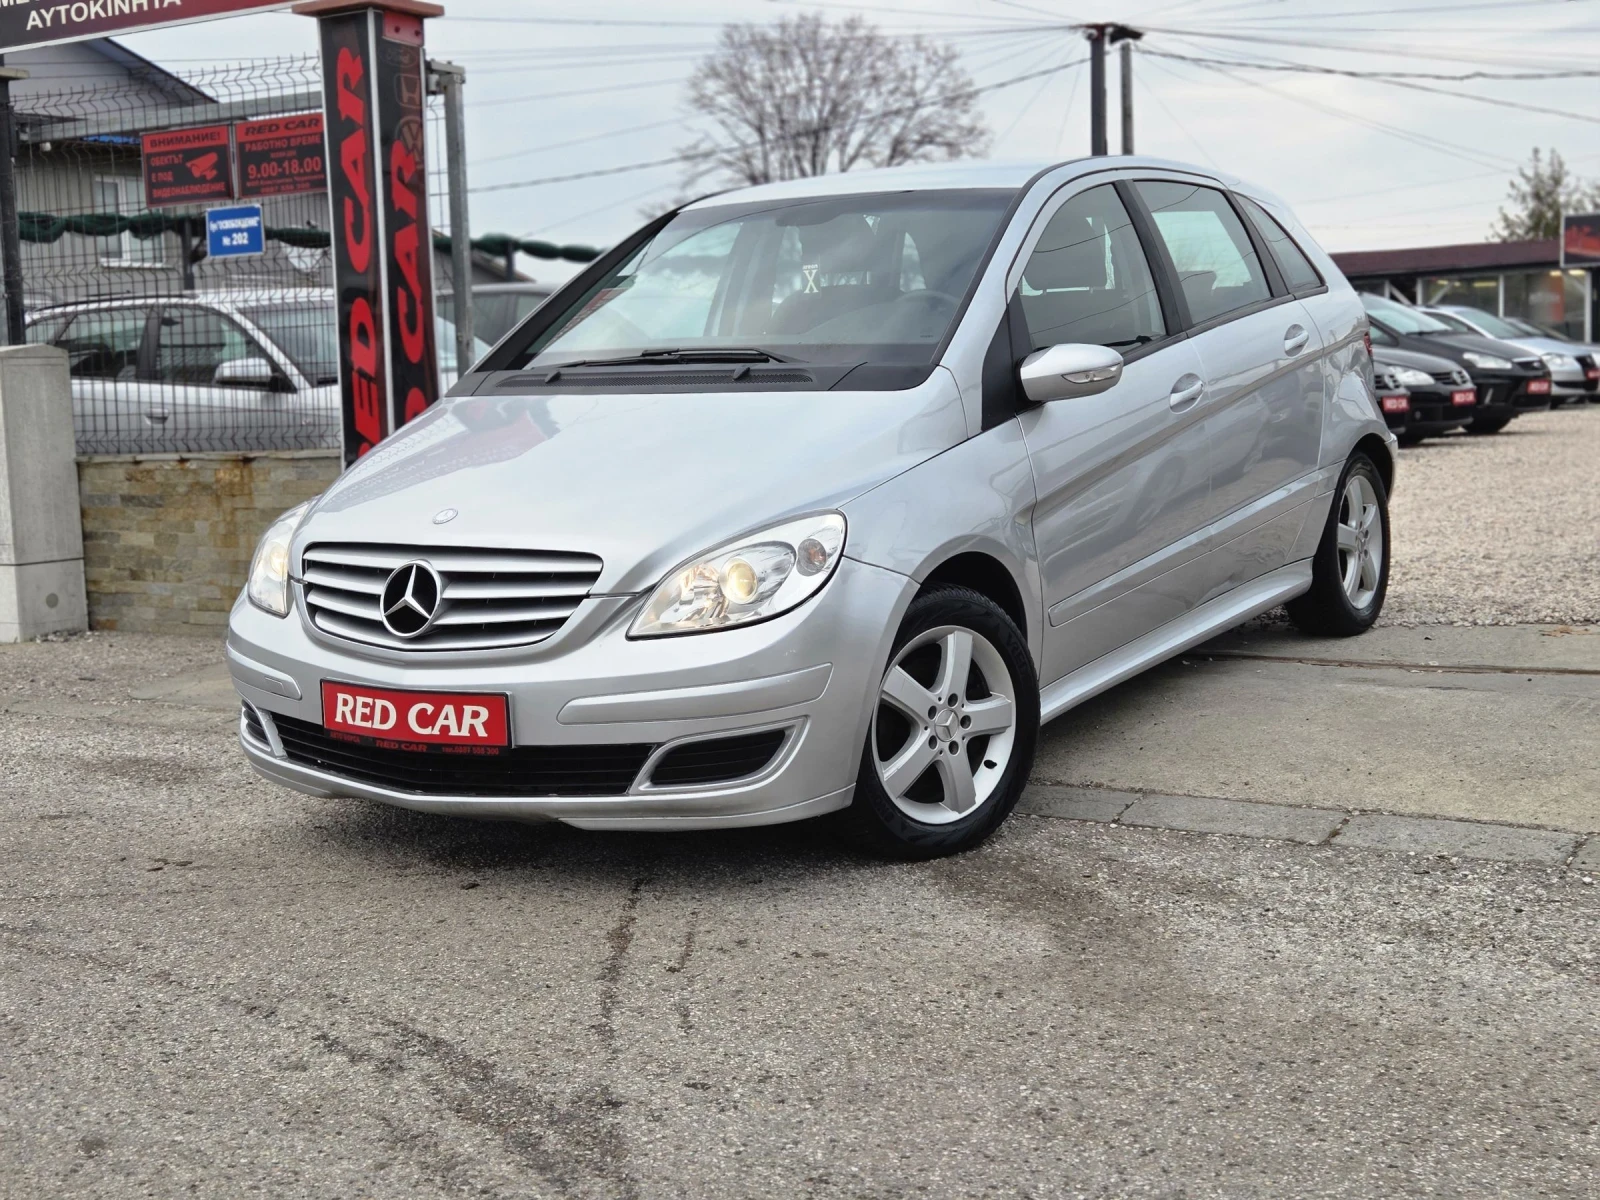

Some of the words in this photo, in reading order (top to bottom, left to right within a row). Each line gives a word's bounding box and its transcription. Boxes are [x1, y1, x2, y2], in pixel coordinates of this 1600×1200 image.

[245, 123, 280, 136] RED
[284, 118, 319, 130] CAR
[150, 132, 220, 148] ВНИМАНИЕ!
[245, 139, 287, 152] РАБОТНО
[290, 134, 321, 147] ВРЕМЕ
[248, 156, 321, 179] 9.00-18.00
[336, 46, 371, 273] CAR
[231, 231, 249, 245] 202
[391, 139, 425, 364] CAR
[803, 269, 819, 293] X
[351, 297, 380, 457] ED
[334, 692, 397, 731] RED
[407, 702, 490, 738] CAR
[376, 739, 399, 749] RED
[401, 743, 428, 752] CAR
